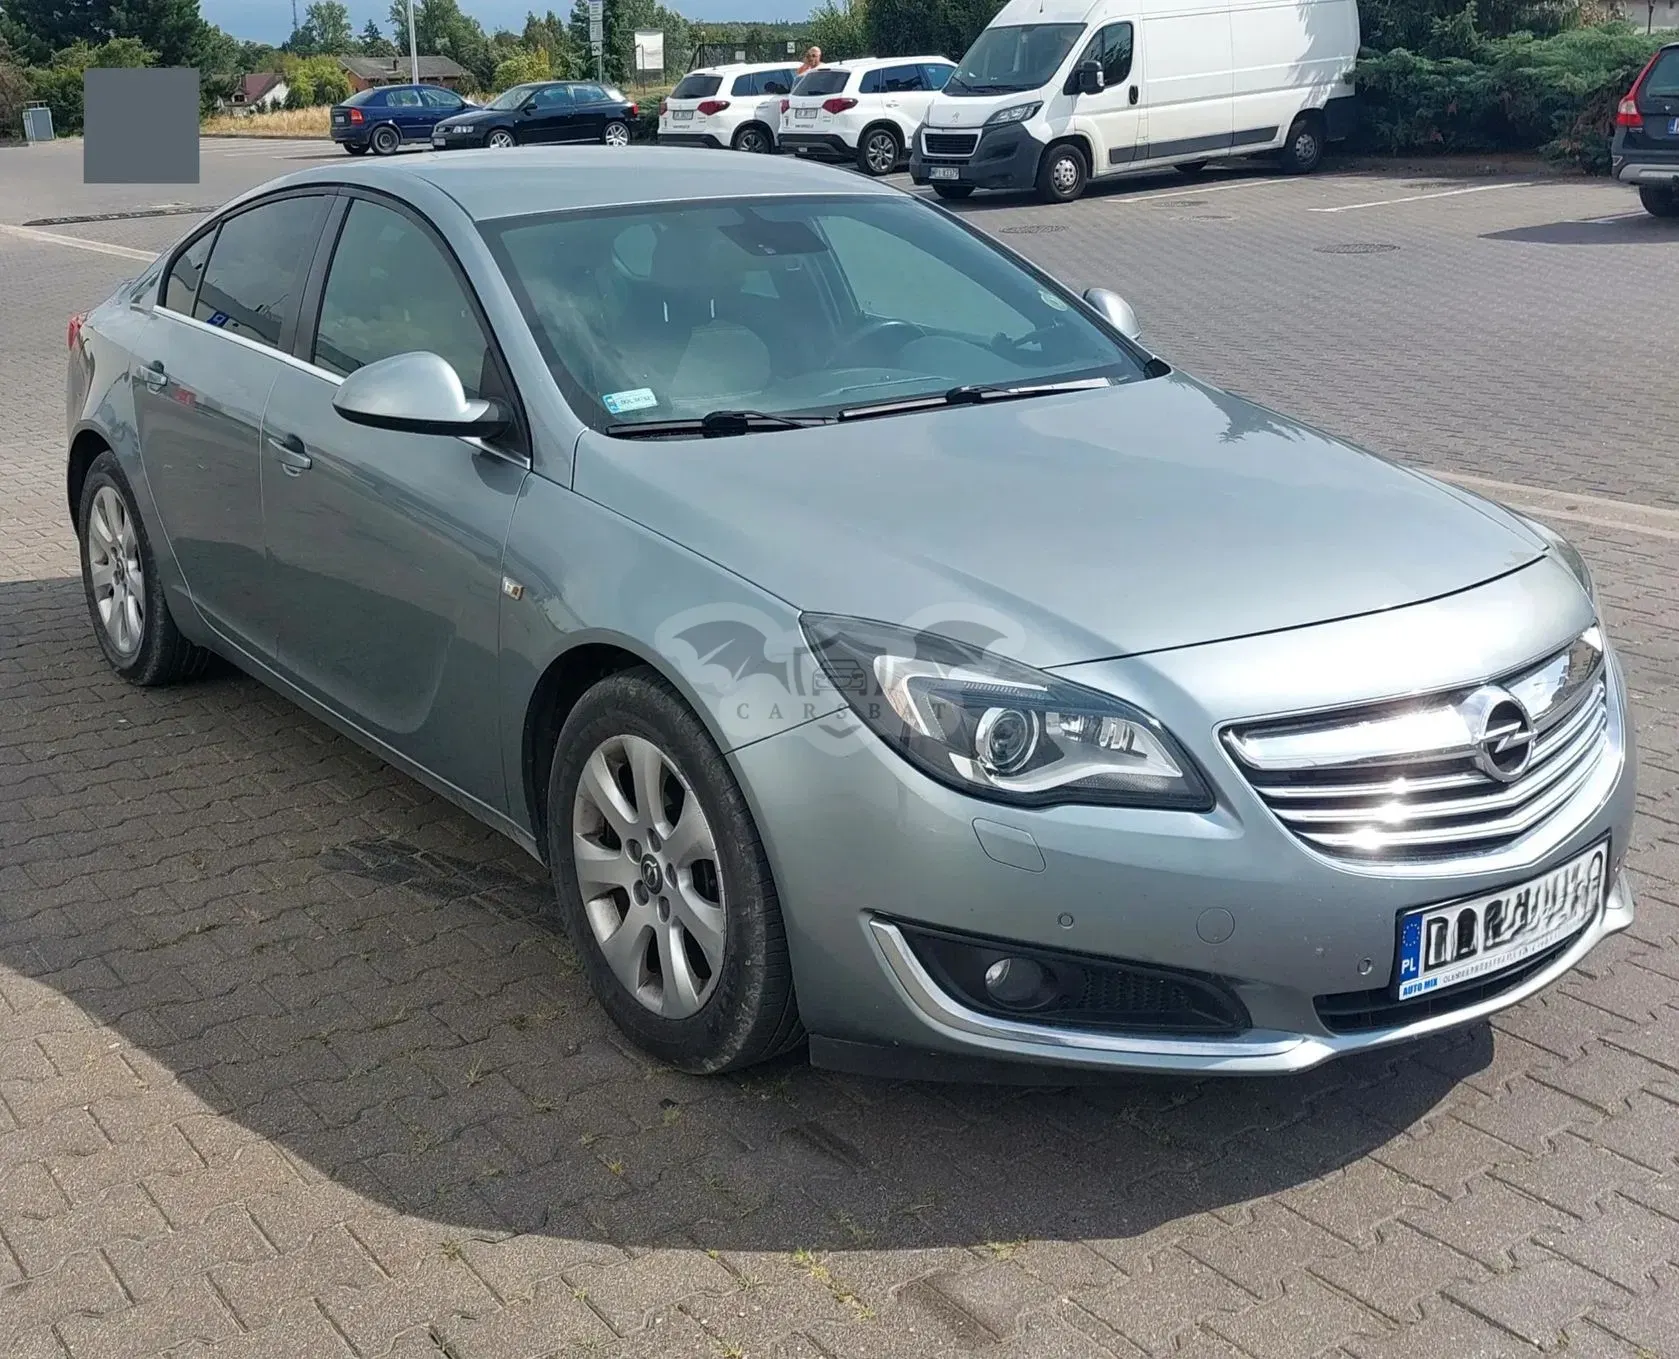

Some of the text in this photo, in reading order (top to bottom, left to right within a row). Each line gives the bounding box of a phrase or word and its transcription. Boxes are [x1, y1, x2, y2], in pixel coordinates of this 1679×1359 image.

[1401, 957, 1417, 975] PL
[1402, 977, 1439, 997] AUTO MIX
